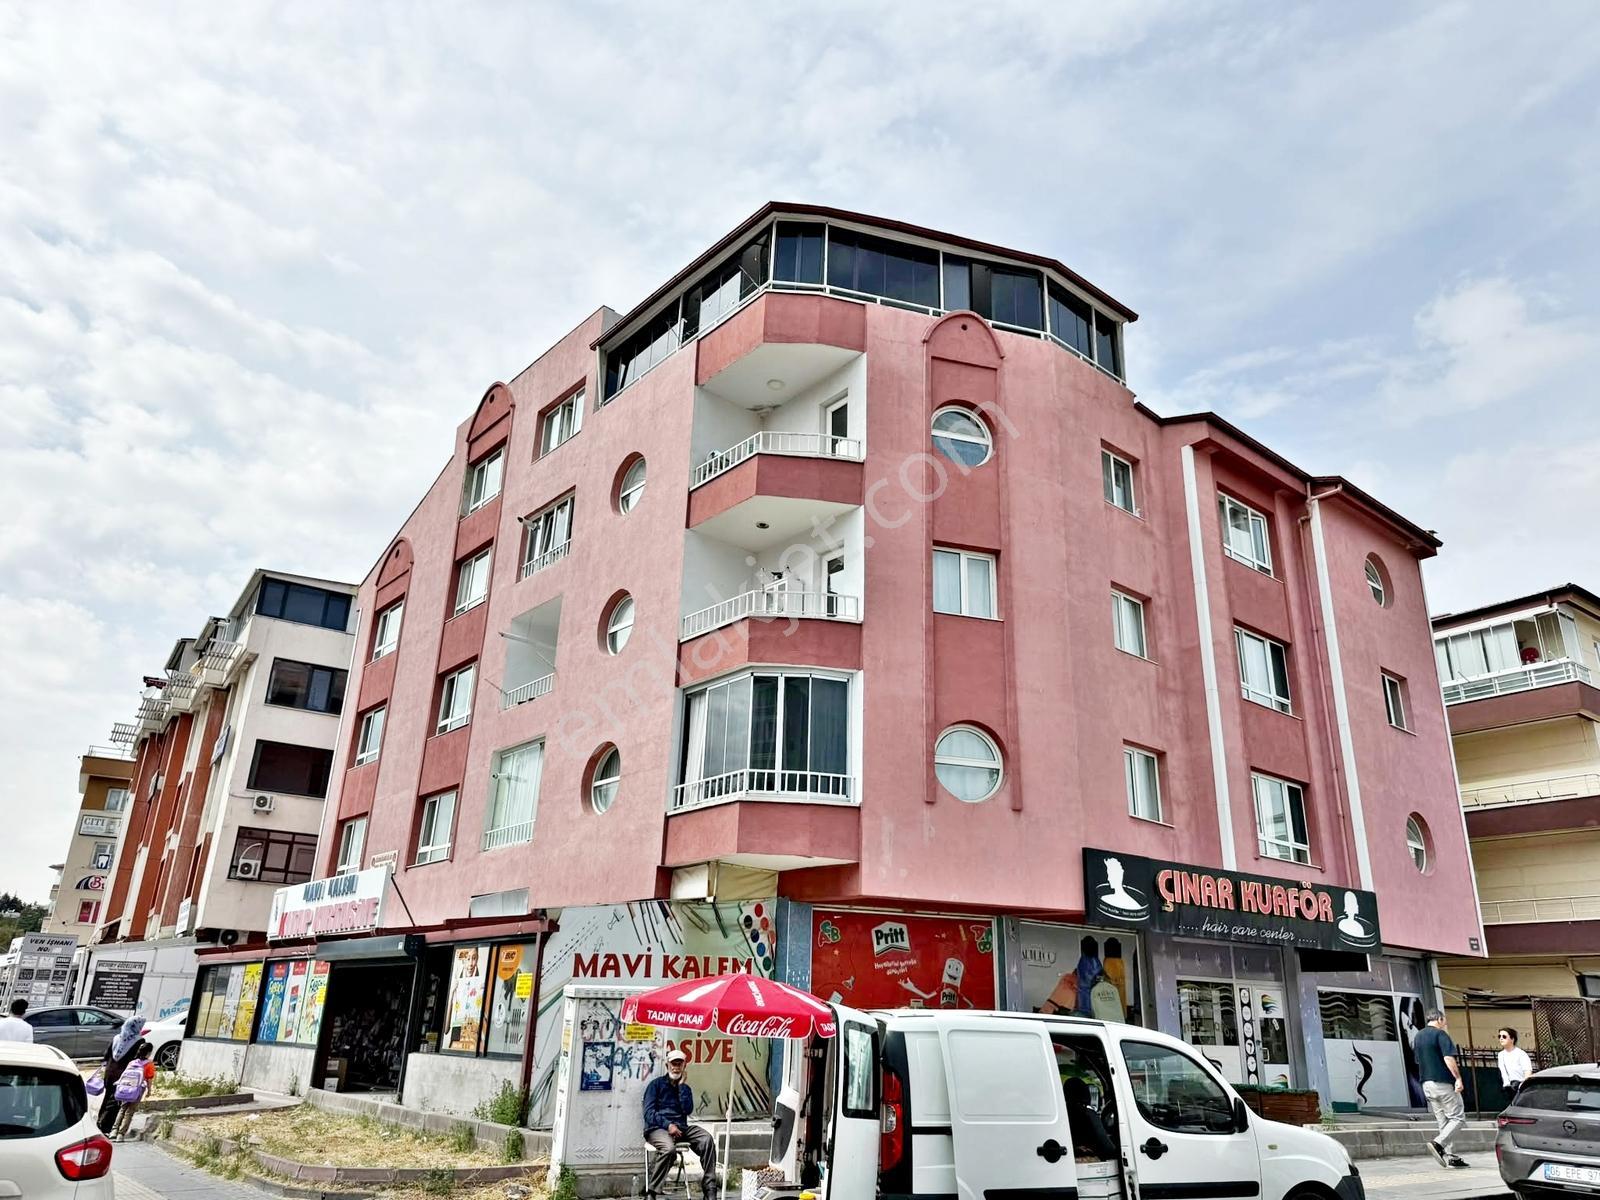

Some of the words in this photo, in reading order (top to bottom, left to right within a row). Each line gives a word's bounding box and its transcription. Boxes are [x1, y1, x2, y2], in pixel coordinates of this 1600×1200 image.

[1156, 868, 1236, 913] ÇINAR
[1240, 880, 1334, 923] KUAFÖR
[875, 927, 906, 946] Pritt
[1202, 916, 1230, 934] hair
[1231, 926, 1258, 938] care
[1260, 927, 1296, 942] center
[572, 946, 653, 978] MAVİ
[647, 1010, 676, 1022] TADINI
[678, 1013, 705, 1025] ÇIKAR
[726, 1013, 796, 1039] Coca-Cola
[1550, 1165, 1561, 1177] 06
[1565, 1167, 1582, 1180] EPE
